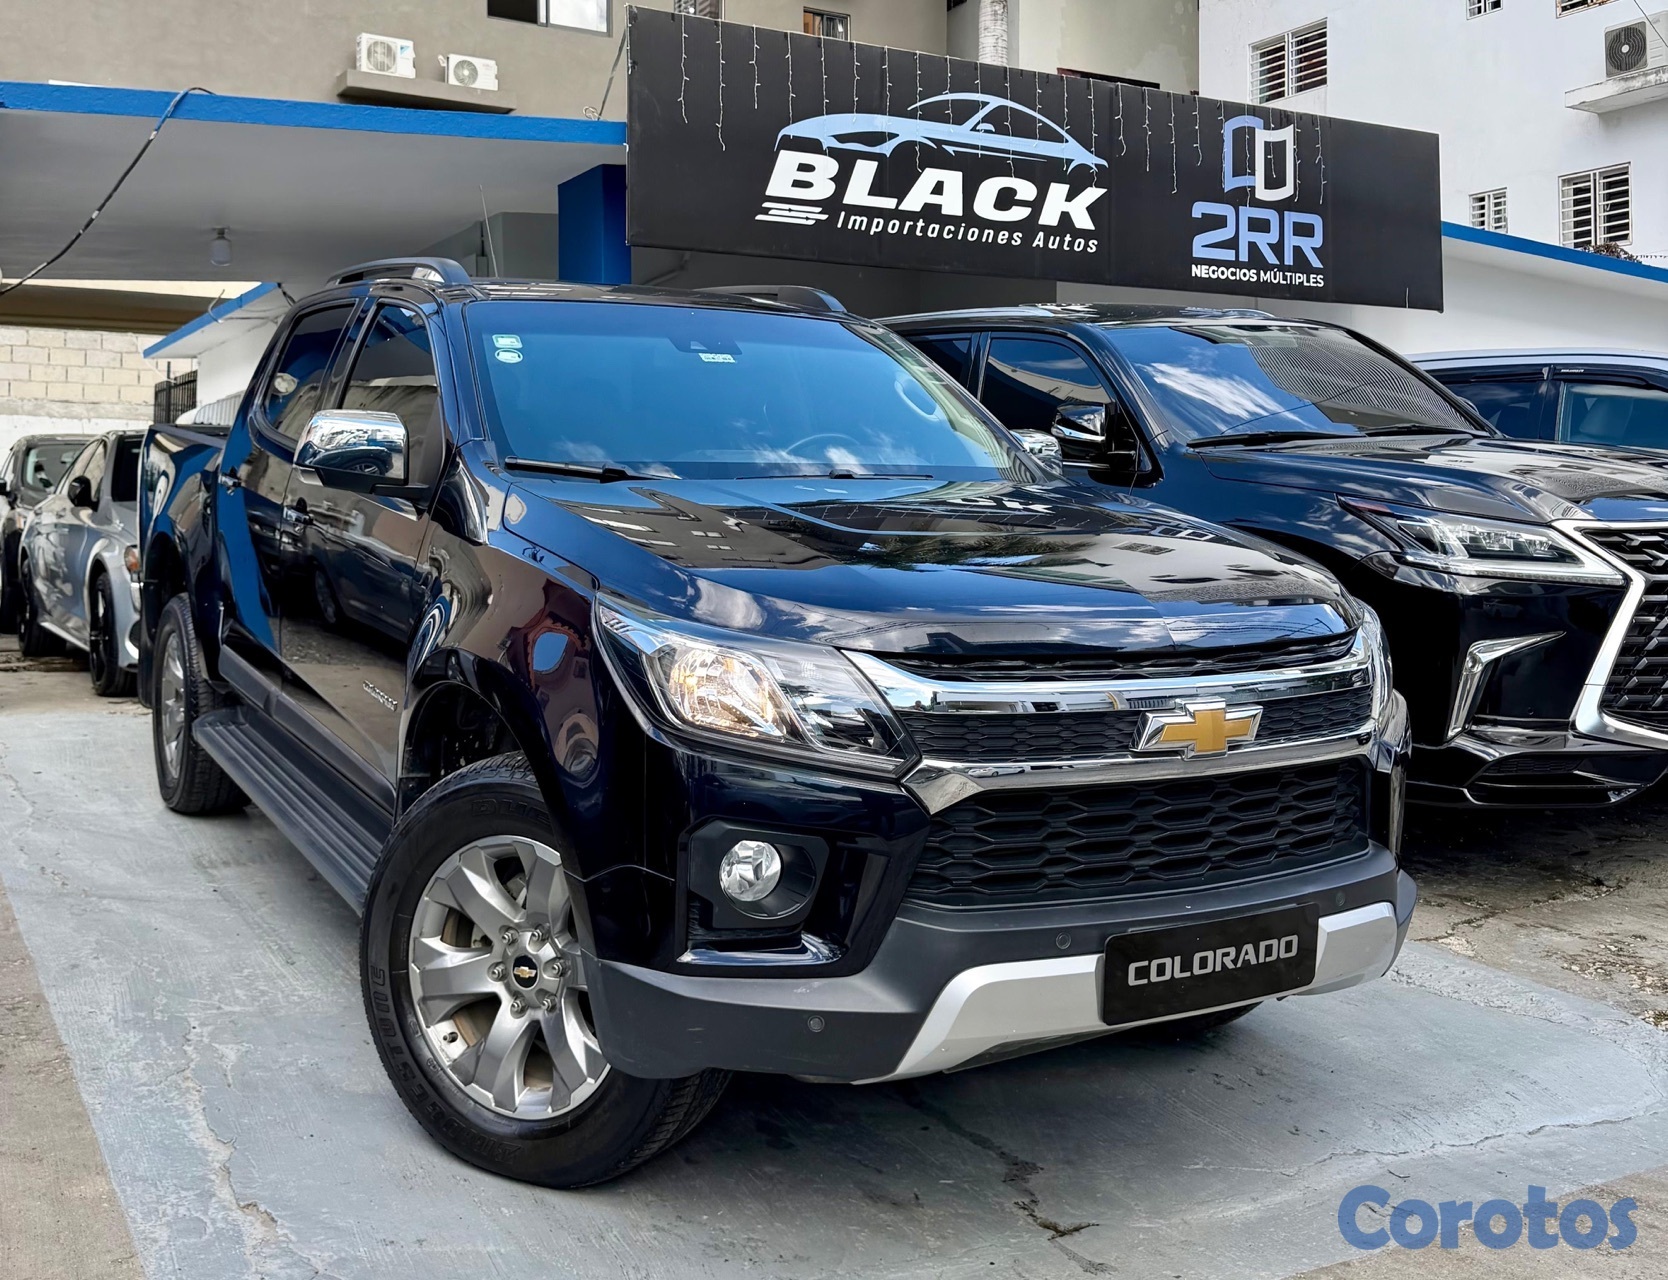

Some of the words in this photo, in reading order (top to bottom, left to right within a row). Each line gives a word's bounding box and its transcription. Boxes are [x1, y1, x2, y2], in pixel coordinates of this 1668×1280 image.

[765, 149, 1108, 231] BLACK
[836, 210, 1023, 246] Importaciones
[1032, 231, 1099, 253] Autos
[1191, 200, 1324, 269] 2RR
[1191, 264, 1258, 283] NEGOCIOS
[1259, 268, 1325, 288] MÚLTIPLES
[1127, 934, 1299, 987] COLORADO
